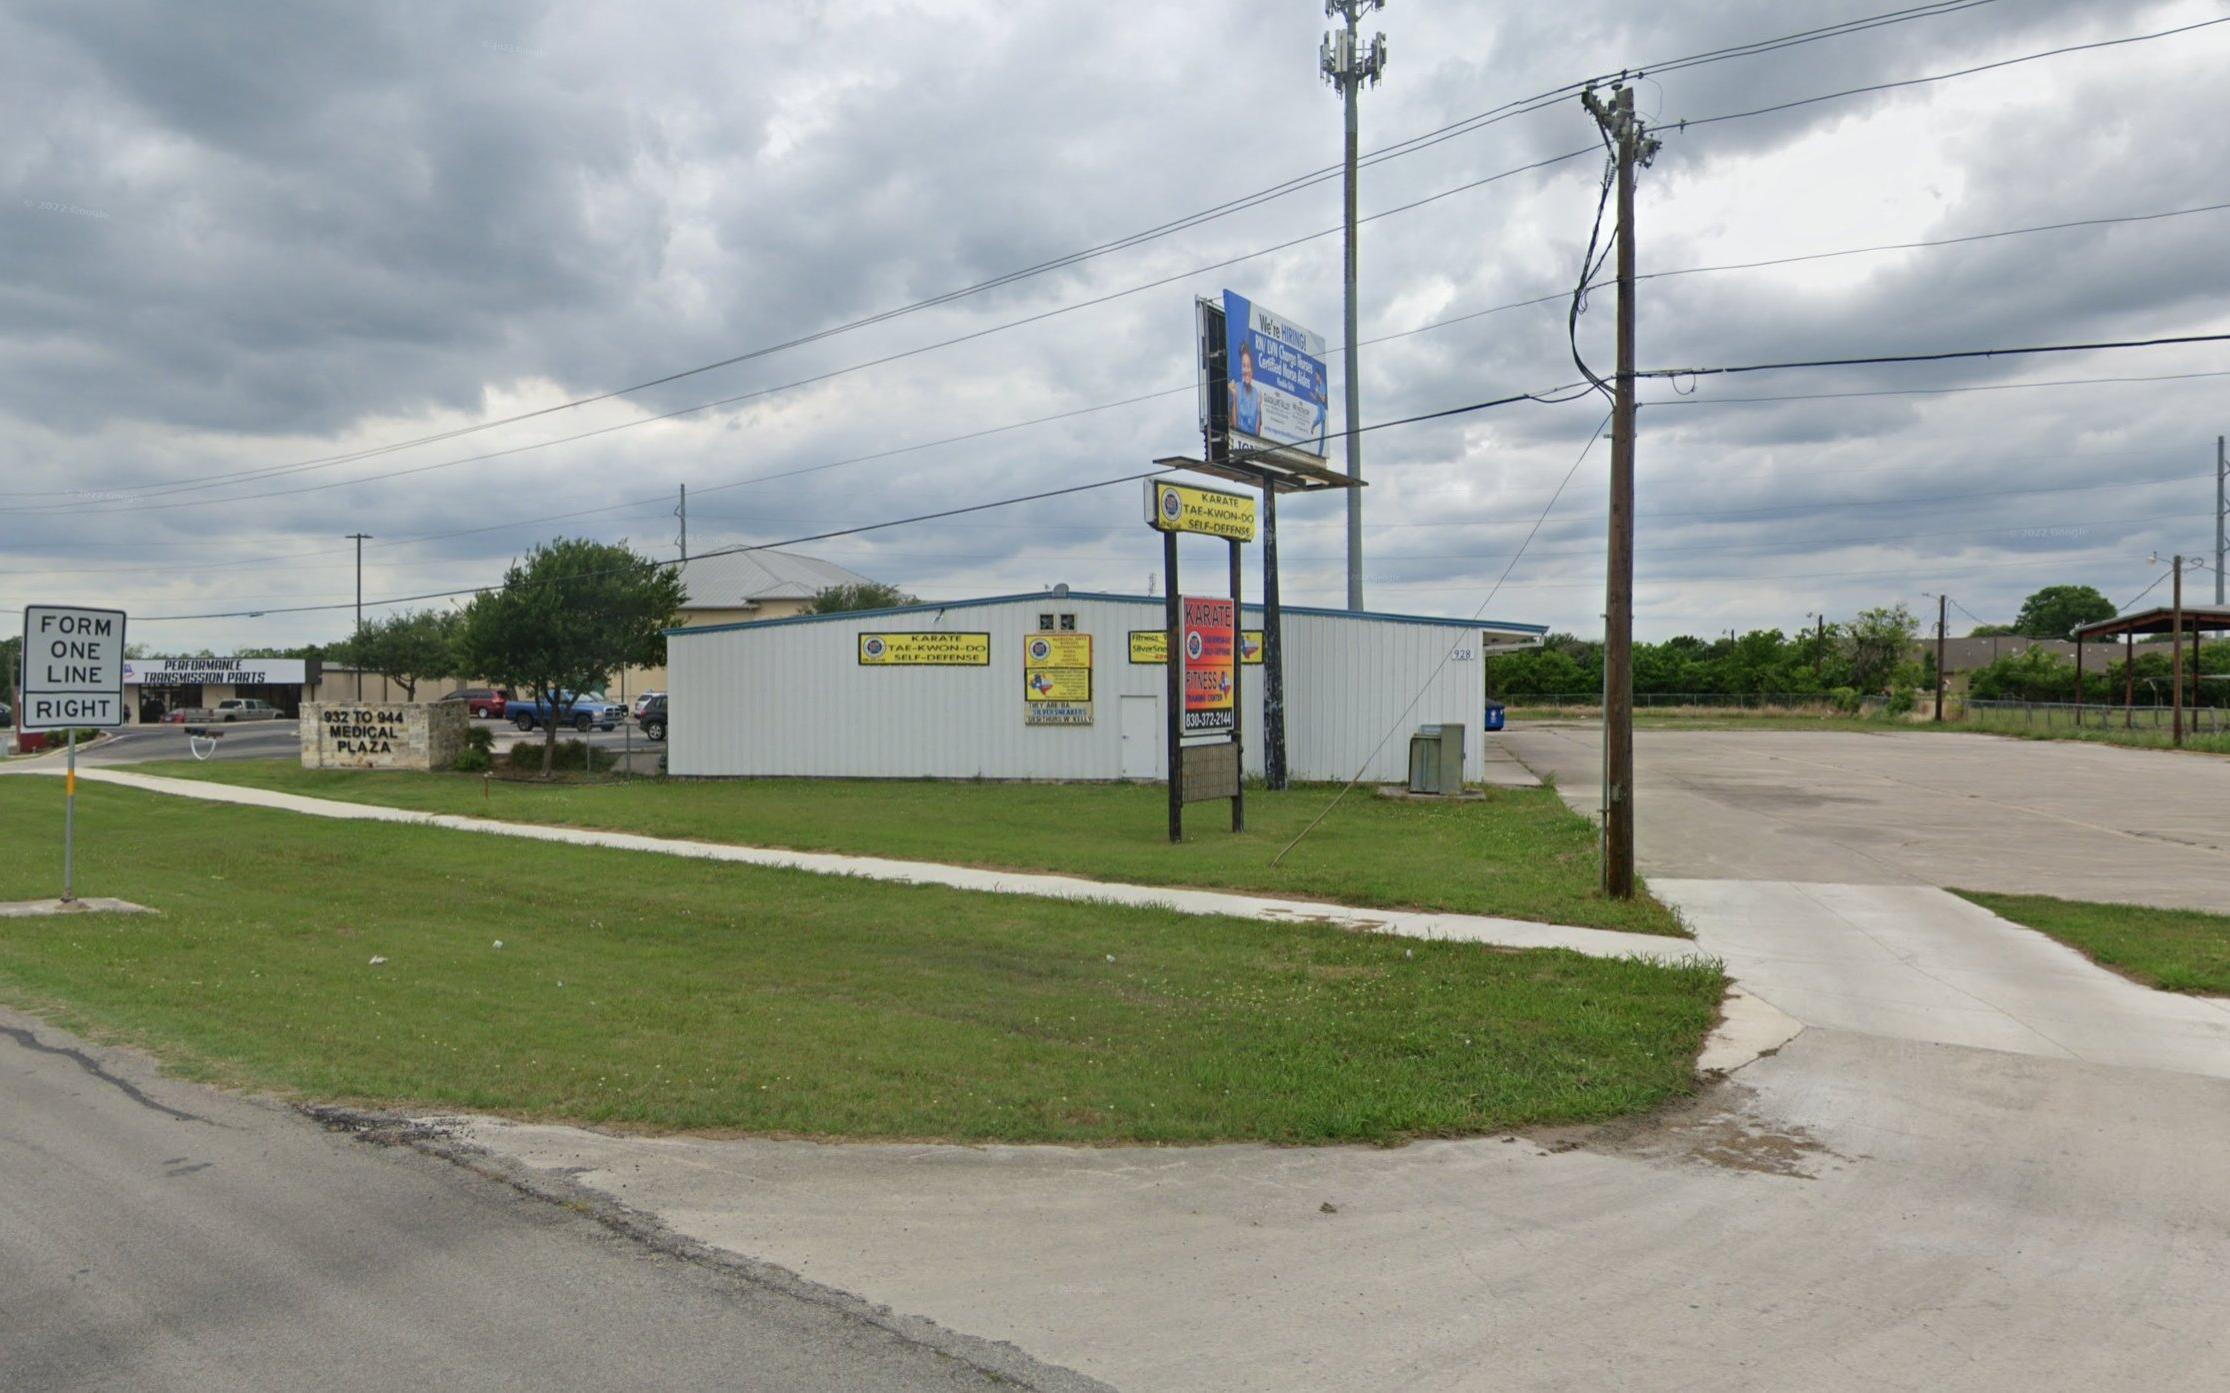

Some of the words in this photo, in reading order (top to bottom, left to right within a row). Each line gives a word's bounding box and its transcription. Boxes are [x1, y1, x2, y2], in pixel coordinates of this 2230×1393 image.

[1259, 313, 1280, 339] We're
[1281, 323, 1307, 352] HIRING!
[1201, 493, 1239, 507] KARATE
[1183, 504, 1255, 523] TAE-KWON-DO
[1188, 519, 1251, 536] SELF-DEFENSE
[1185, 603, 1231, 628] KARATE
[41, 615, 112, 637] FORM
[51, 640, 101, 660] ONE
[888, 644, 987, 652] TAE-KWON-DO
[1454, 649, 1471, 659] 928
[164, 660, 242, 671] PERFORMANCE
[894, 654, 980, 662] SELF-DEFENSE
[47, 665, 102, 684] LINE
[144, 672, 224, 684] TRANSMISSION
[227, 672, 266, 684] PARTS
[1186, 671, 1217, 690] FITNESS
[36, 699, 111, 719] RIGHT
[324, 711, 349, 723] 932
[353, 711, 373, 723] TO
[377, 711, 404, 723] 944
[330, 726, 398, 739] MEDICAL
[338, 741, 391, 753] PLAZA
